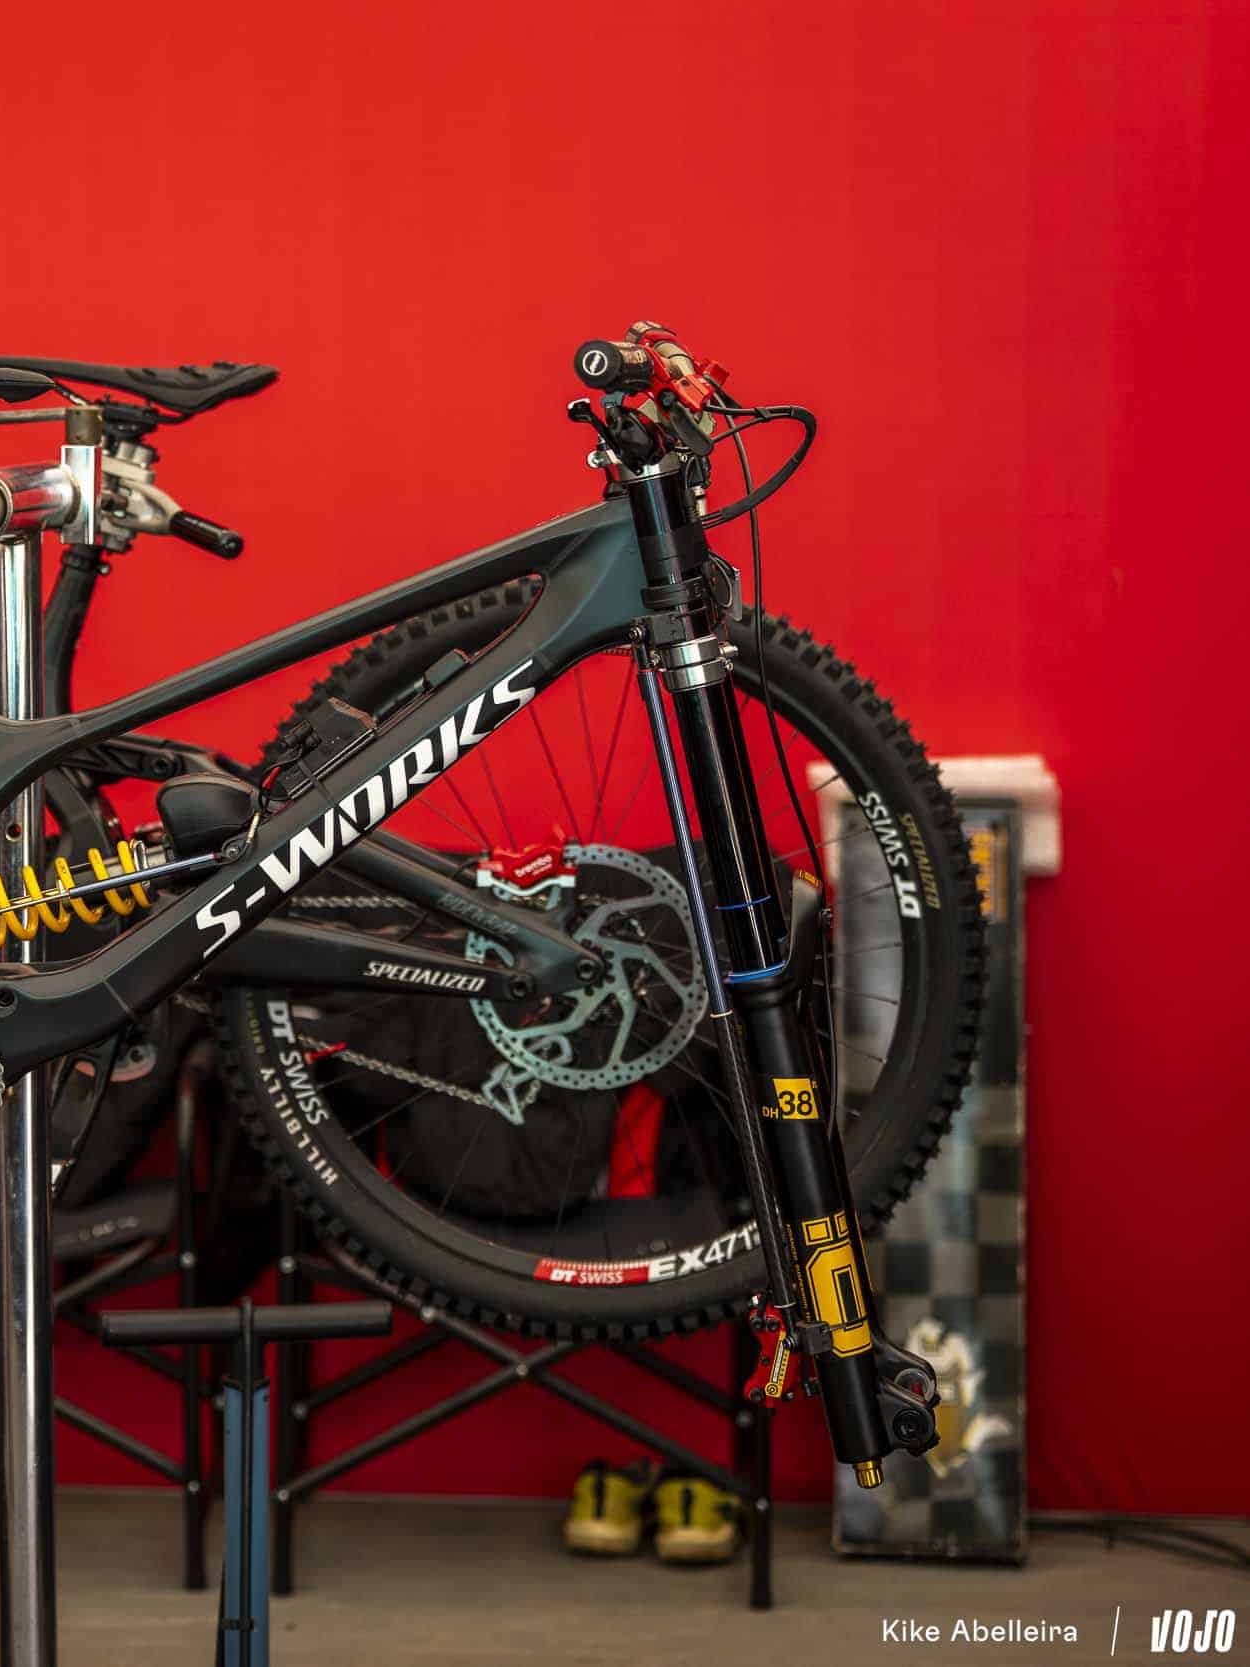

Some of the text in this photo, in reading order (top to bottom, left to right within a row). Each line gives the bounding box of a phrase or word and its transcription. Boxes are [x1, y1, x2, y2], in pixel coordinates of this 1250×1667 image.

[196, 659, 536, 958] S-WORKS
[859, 792, 921, 918] DT SWISS
[364, 961, 486, 992] SPECIALIZED
[267, 1001, 330, 1125] DT SWISS
[260, 1067, 340, 1186] HILLBILLY
[550, 1268, 624, 1285] DT SWISS
